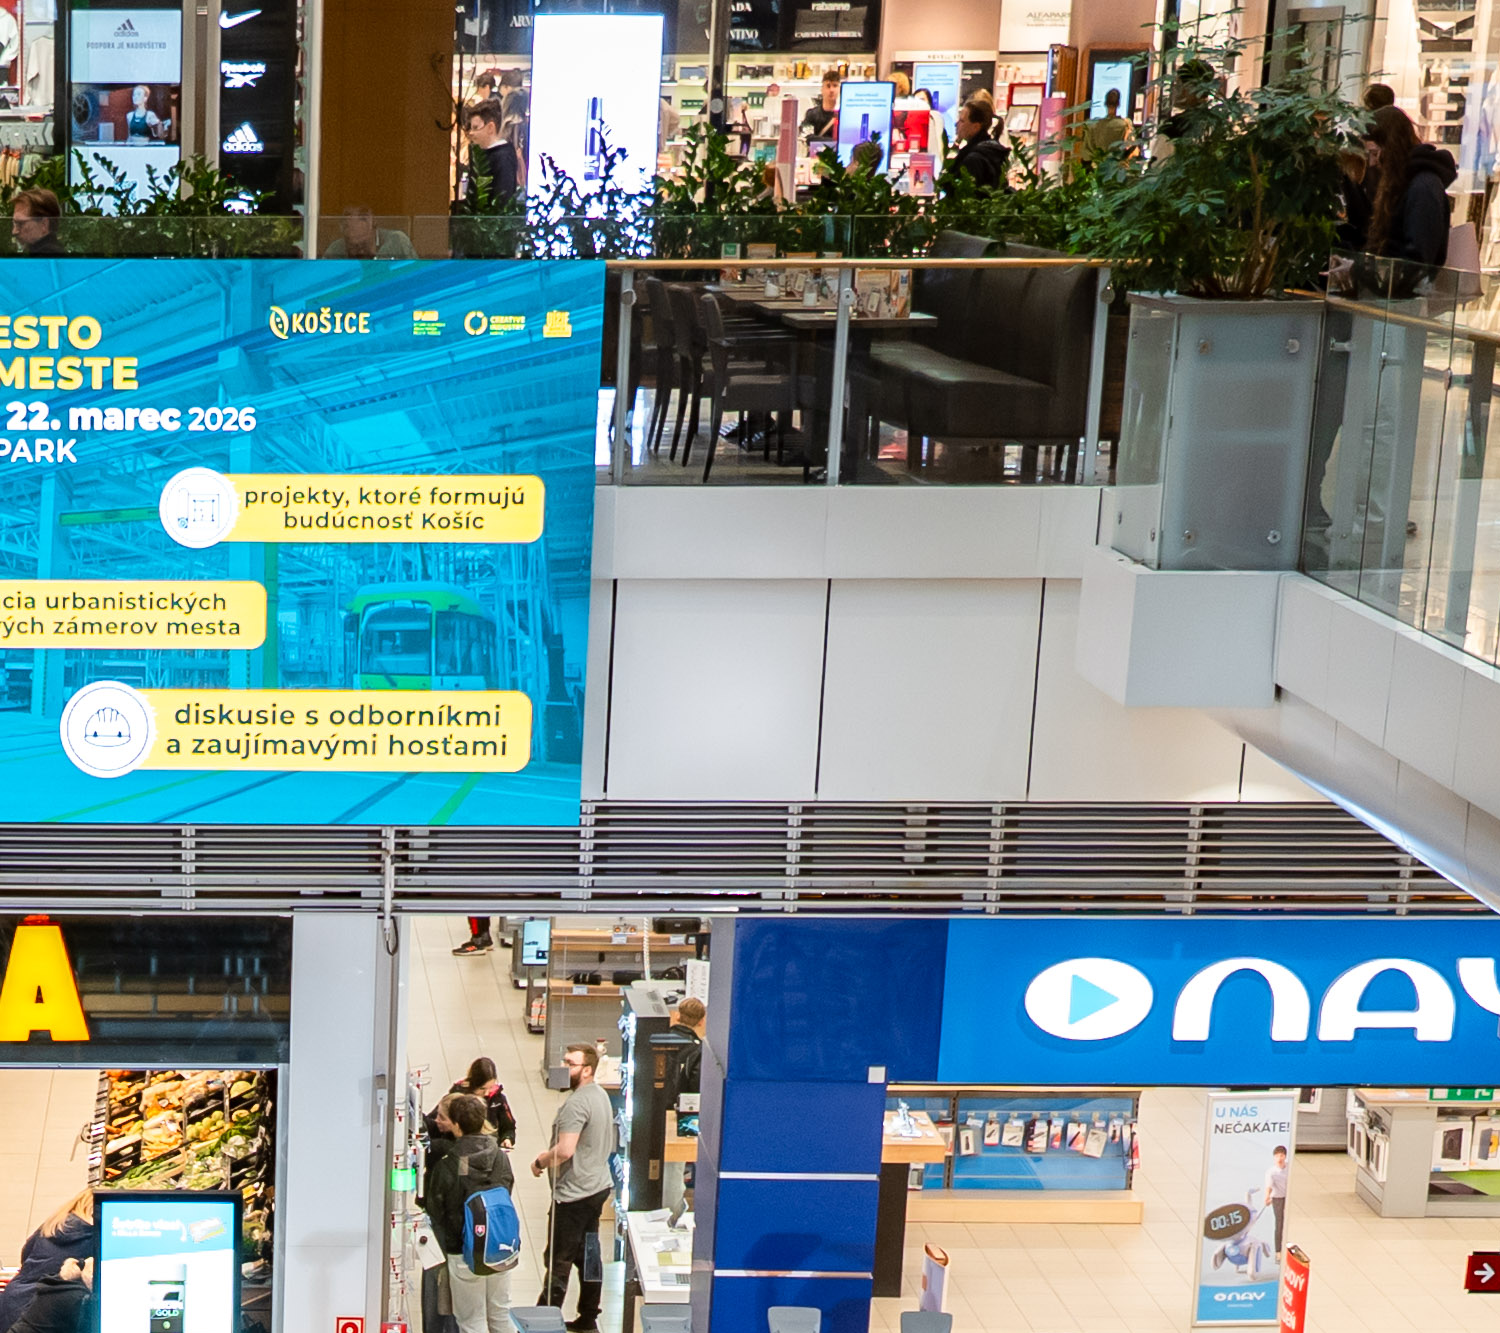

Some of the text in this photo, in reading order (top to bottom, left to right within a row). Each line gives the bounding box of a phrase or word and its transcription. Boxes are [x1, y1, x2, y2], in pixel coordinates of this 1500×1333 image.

[220, 62, 266, 77] Reebok
[222, 141, 264, 153] adidas
[292, 308, 370, 333] KOŠICE
[7, 402, 61, 432] 22.
[68, 408, 181, 432] marec
[188, 407, 256, 432] 2026
[245, 485, 525, 510] projekty, ktoré formujú
[284, 511, 484, 530] budúcnosť Košíc
[45, 591, 227, 615] urbanistických
[54, 617, 158, 636] zámerov
[168, 619, 241, 636] mesta
[175, 701, 500, 727] diskusie s odborníkmi
[167, 730, 507, 761] a zaujímavými hosťami
[1216, 1105, 1258, 1118] U NÁS
[1214, 1120, 1290, 1135] NEČAKÁTE!
